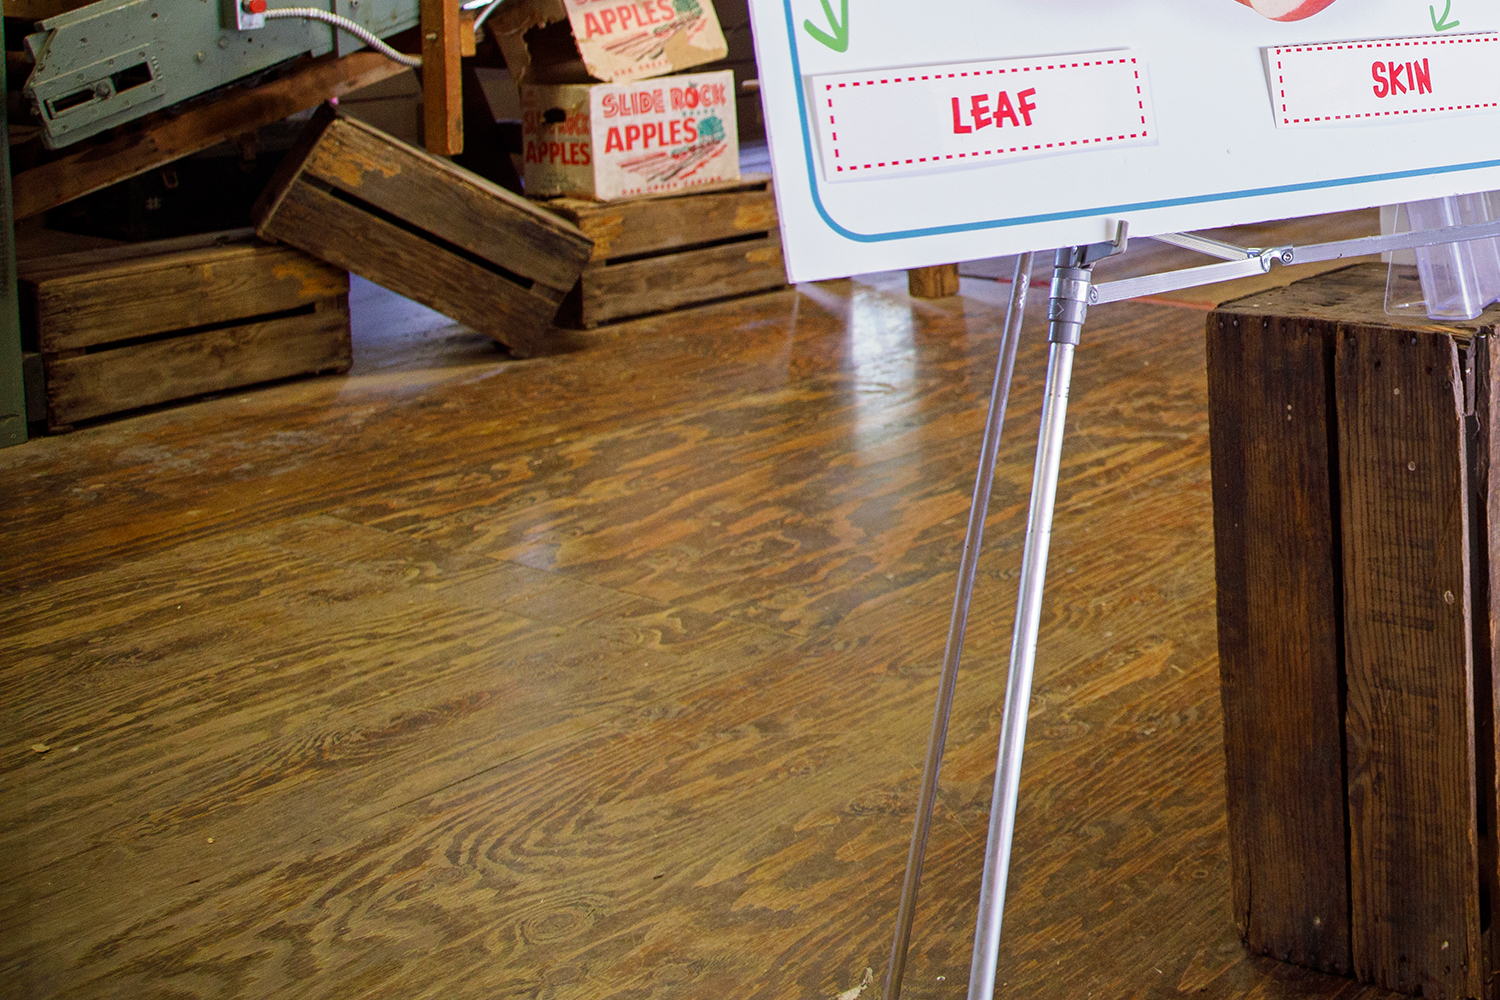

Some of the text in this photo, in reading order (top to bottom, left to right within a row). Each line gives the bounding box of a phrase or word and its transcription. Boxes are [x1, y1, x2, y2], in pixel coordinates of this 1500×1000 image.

[1371, 57, 1433, 99] SKIN
[602, 82, 726, 118] SLIDE ROCK
[951, 87, 1037, 135] LEAF
[525, 141, 592, 167] APPLES
[604, 117, 698, 154] APPLES
